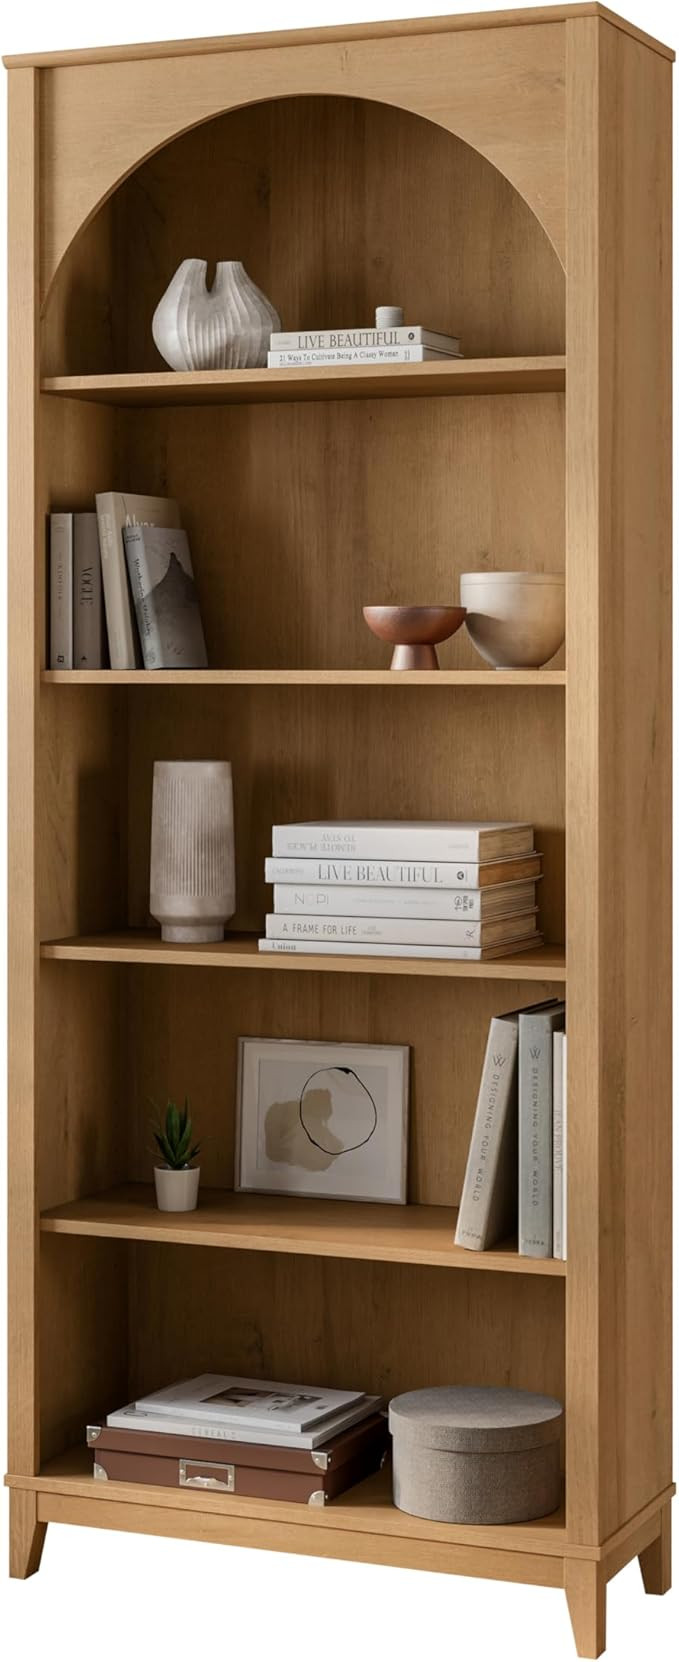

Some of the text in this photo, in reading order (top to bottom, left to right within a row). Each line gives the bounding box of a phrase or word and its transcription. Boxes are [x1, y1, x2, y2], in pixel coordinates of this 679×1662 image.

[298, 331, 400, 349] LIVE BEAUTIFUL
[336, 351, 352, 361] Being
[353, 351, 359, 359] A
[80, 567, 94, 607] VOGUE
[318, 864, 352, 880] LIVE
[357, 865, 443, 883] BEAUTIFUL
[282, 923, 289, 932] A
[292, 923, 319, 934] FRAME
[322, 925, 337, 935] FOR
[340, 925, 357, 935] LIFE
[484, 1073, 500, 1129] DESIGNING
[479, 1135, 490, 1161] YOUR
[472, 1165, 484, 1202] WORLD
